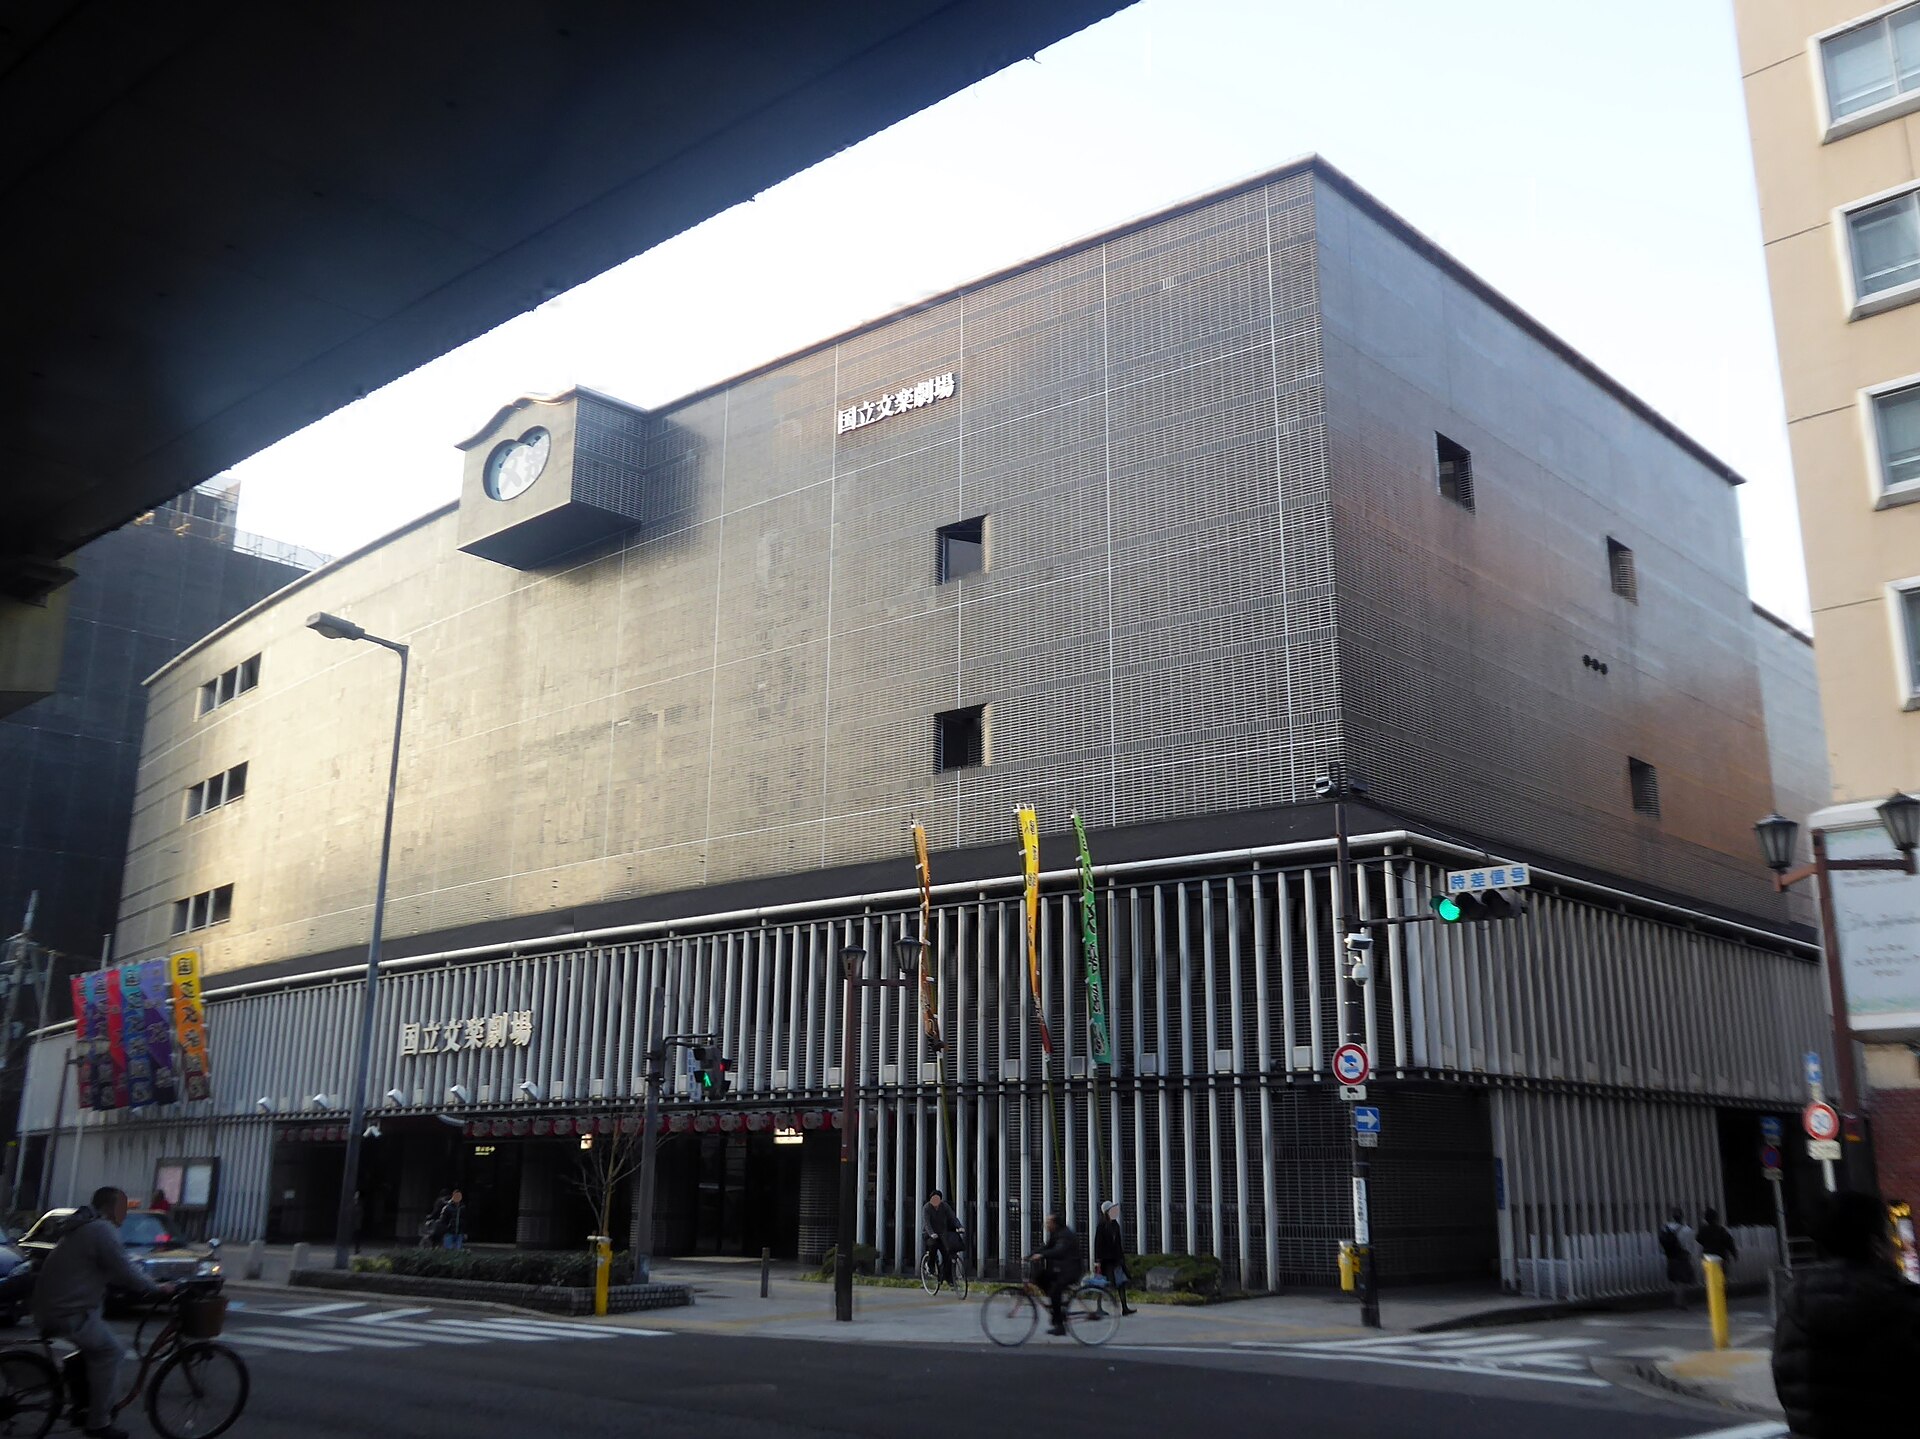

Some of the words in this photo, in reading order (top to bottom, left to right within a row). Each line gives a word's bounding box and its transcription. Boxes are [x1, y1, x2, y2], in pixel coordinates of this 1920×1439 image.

[838, 372, 955, 434] 国立文楽劇場
[1450, 867, 1526, 890] 時差信号
[401, 1010, 533, 1056] 国立文楽劇場
